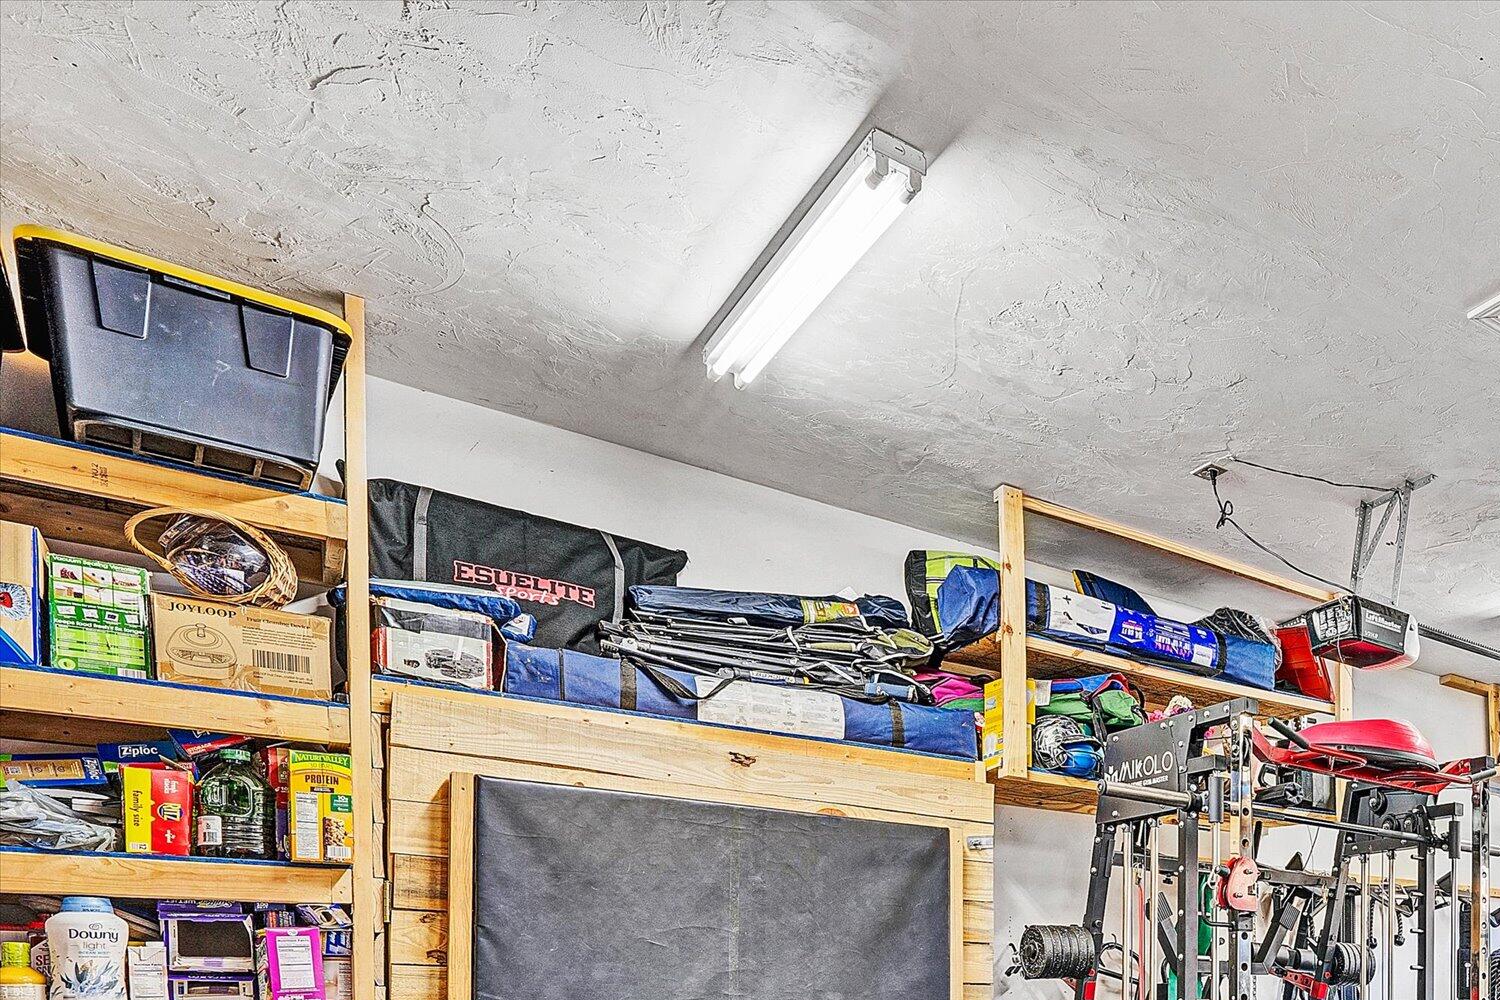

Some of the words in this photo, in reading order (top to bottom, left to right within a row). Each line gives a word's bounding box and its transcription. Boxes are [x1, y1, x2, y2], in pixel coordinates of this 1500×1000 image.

[454, 560, 596, 609] ESUELITE
[168, 601, 237, 619] JOYLOOP
[262, 618, 290, 628] Cleaning
[290, 622, 311, 630] Device
[120, 745, 159, 758] Ziploc
[323, 754, 348, 766] VALLEY
[1119, 750, 1173, 782] MIKOLO
[304, 774, 340, 786] PROTEIN
[130, 790, 143, 812] family
[164, 804, 182, 821] RITZ
[133, 814, 142, 827] size
[68, 928, 119, 943] Downy
[82, 941, 106, 952] light
